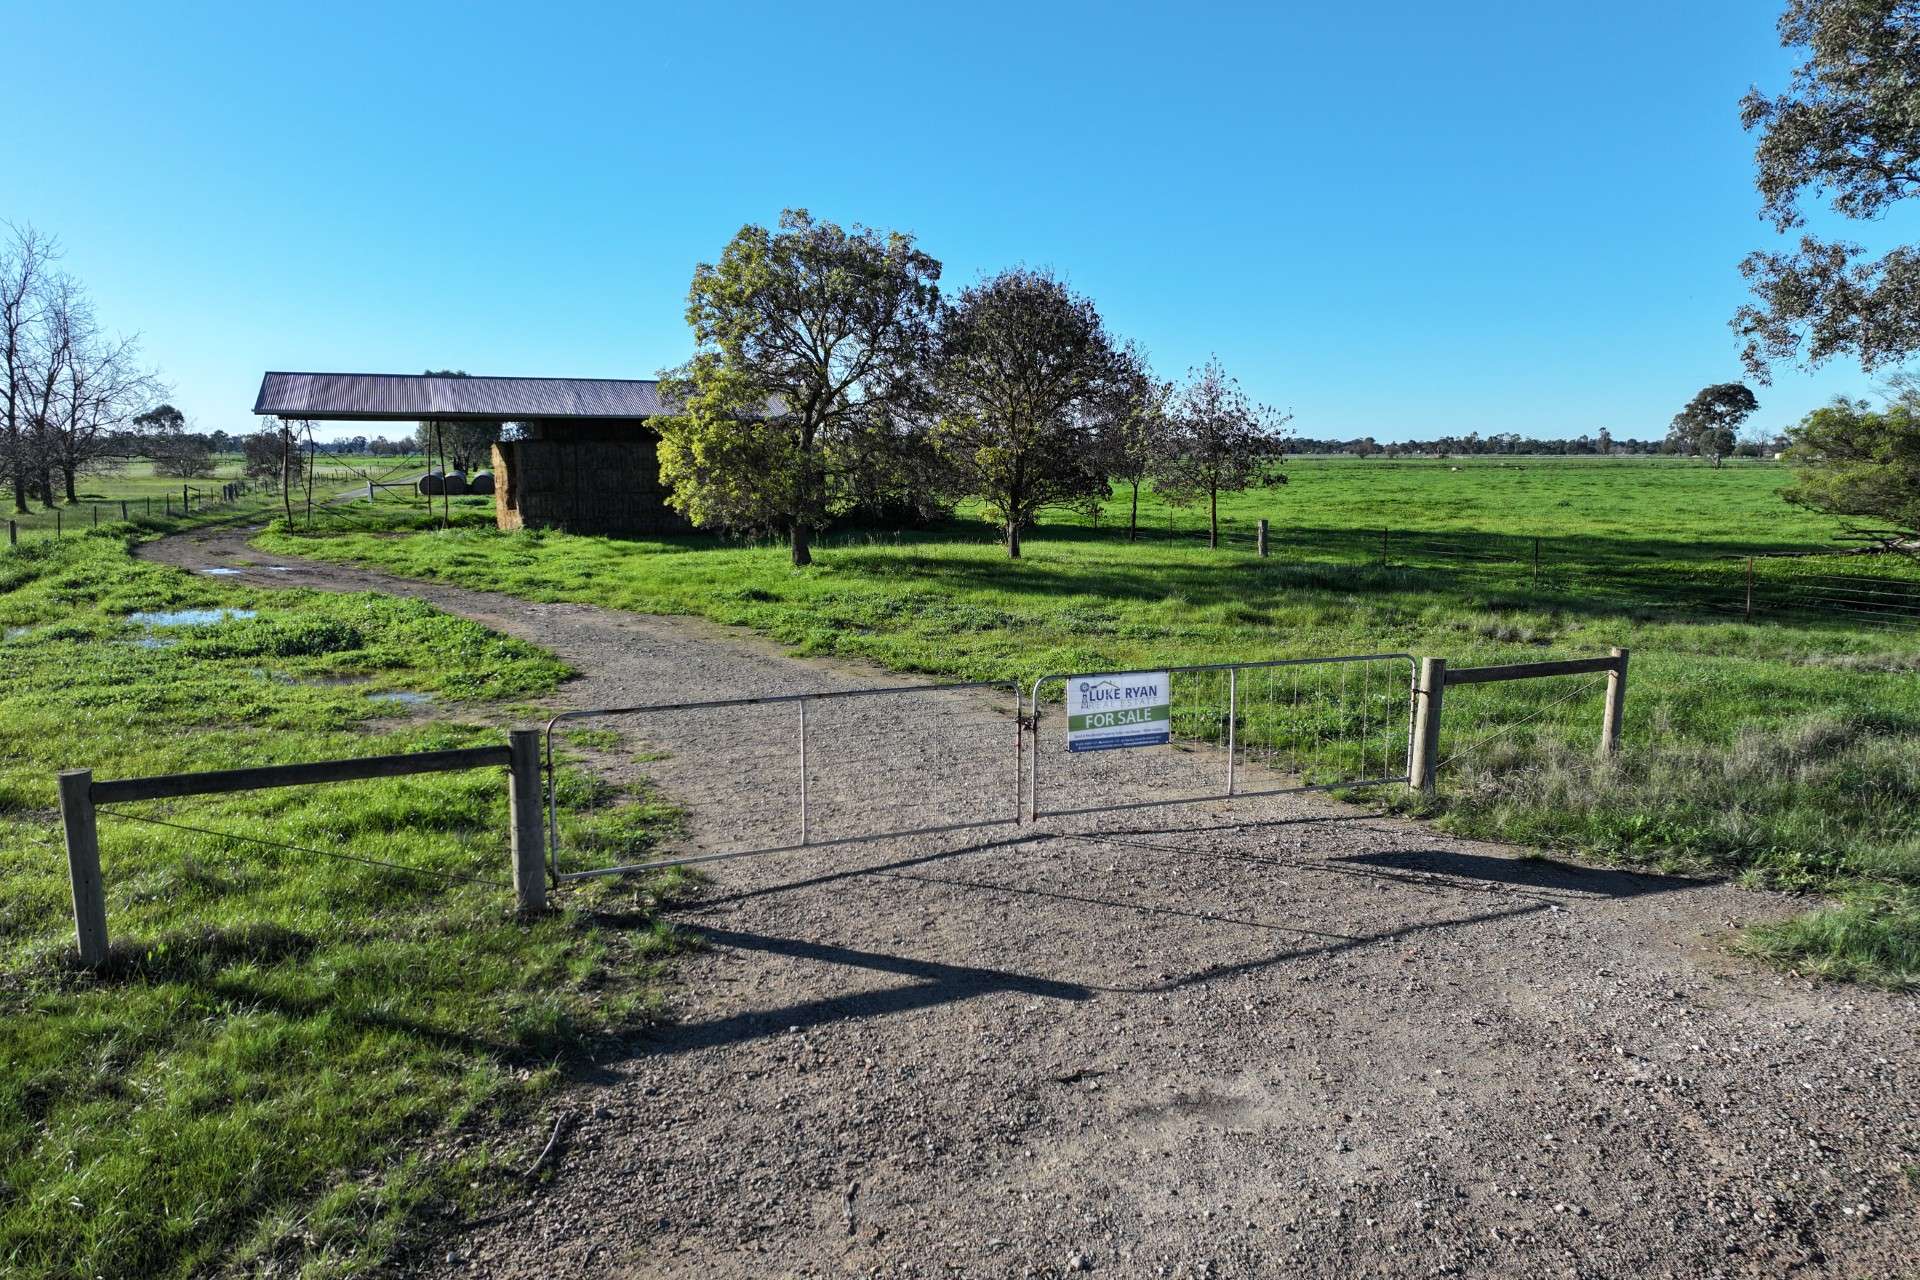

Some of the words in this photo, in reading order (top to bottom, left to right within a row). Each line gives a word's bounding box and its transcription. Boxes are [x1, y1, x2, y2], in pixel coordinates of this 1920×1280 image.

[1089, 688, 1120, 702] LUKE
[1125, 685, 1157, 698] RYAN
[1090, 701, 1114, 709] REAL
[1121, 698, 1158, 706] ESTATE
[1086, 712, 1115, 729] FOR
[1118, 708, 1152, 724] SALE
